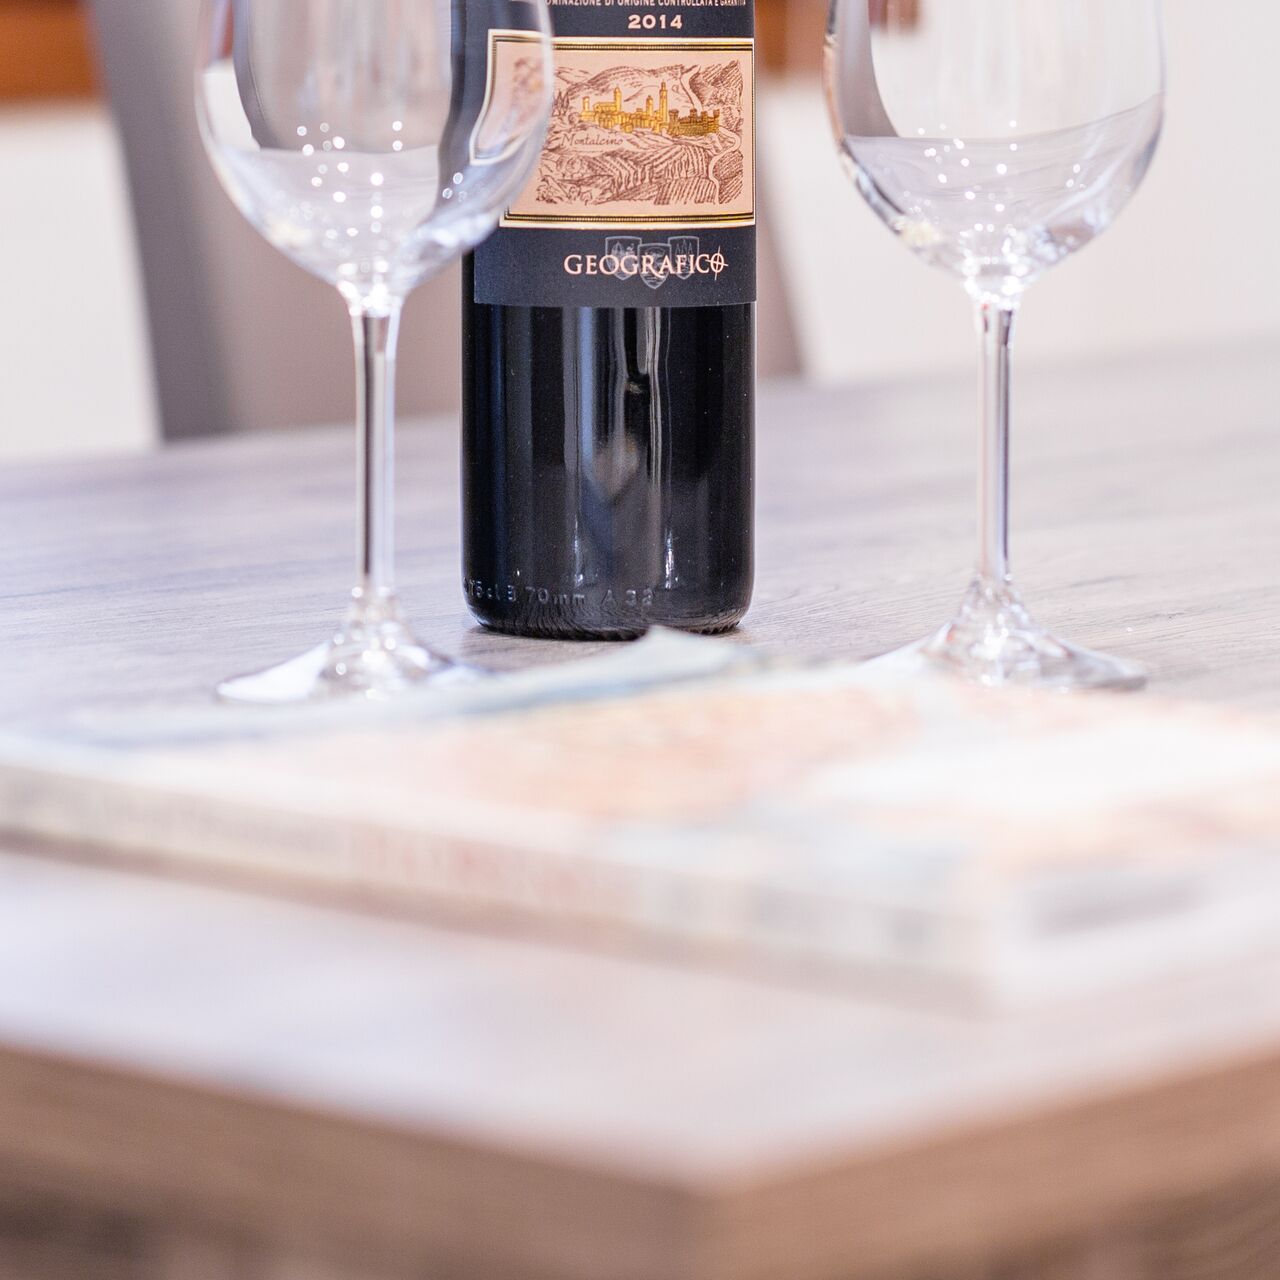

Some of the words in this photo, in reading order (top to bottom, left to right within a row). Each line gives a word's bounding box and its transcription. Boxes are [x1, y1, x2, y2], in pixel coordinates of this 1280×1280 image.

[628, 14, 682, 29] 2014
[561, 133, 624, 146] Montalcino
[563, 253, 726, 277] GEOGRAFICO
